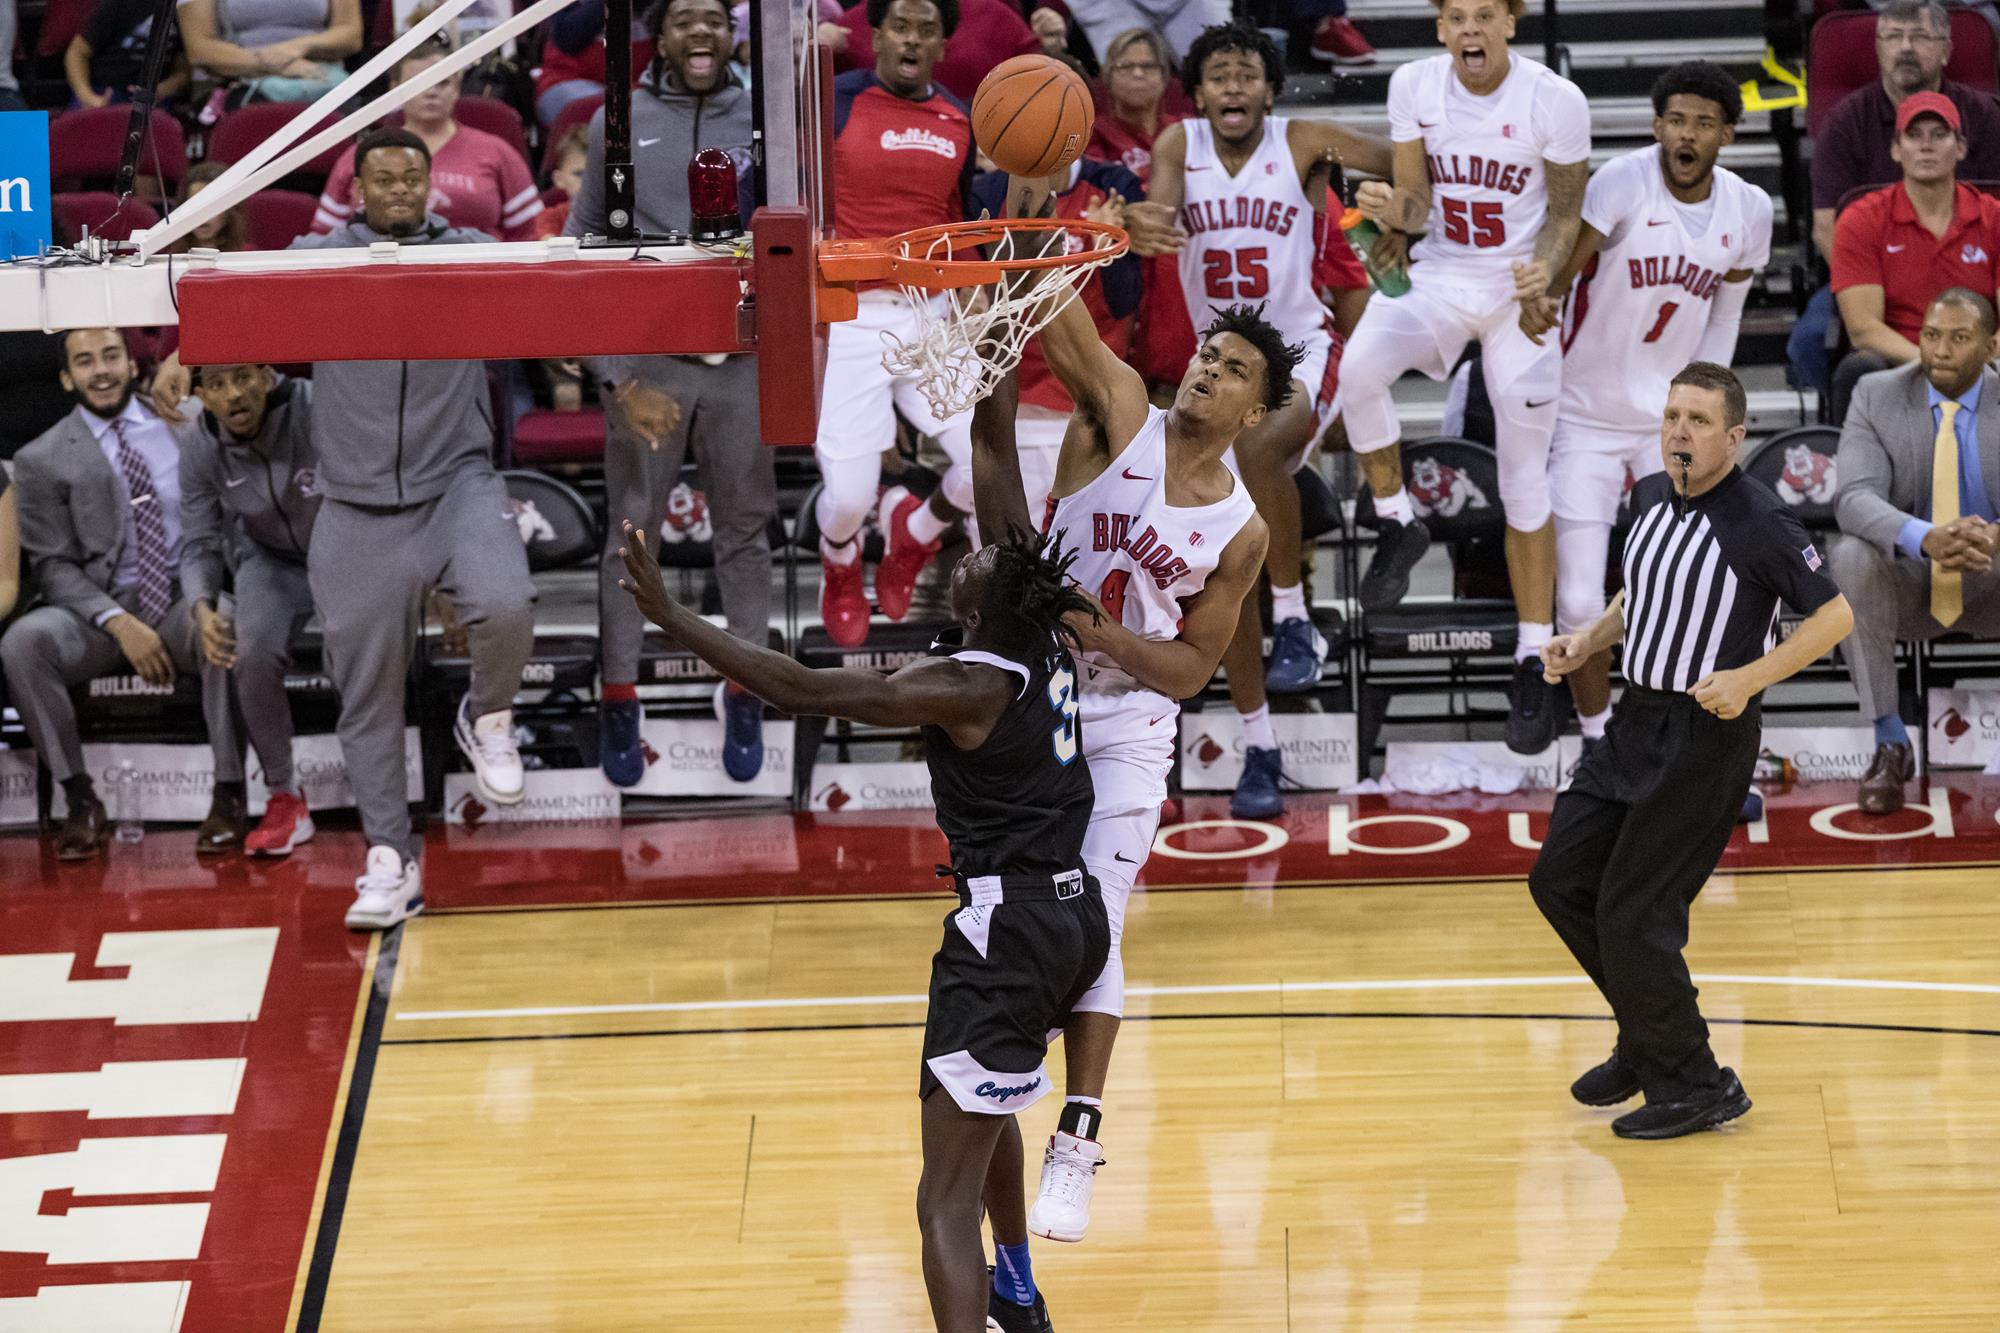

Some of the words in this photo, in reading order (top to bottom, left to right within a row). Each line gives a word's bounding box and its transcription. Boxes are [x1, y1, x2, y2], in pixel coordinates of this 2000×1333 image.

[1442, 196, 1505, 249] 55
[1203, 246, 1270, 299] 25
[1642, 300, 1680, 343] 1
[1408, 631, 1492, 652] BULLDOGS
[1046, 663, 1080, 767] 3
